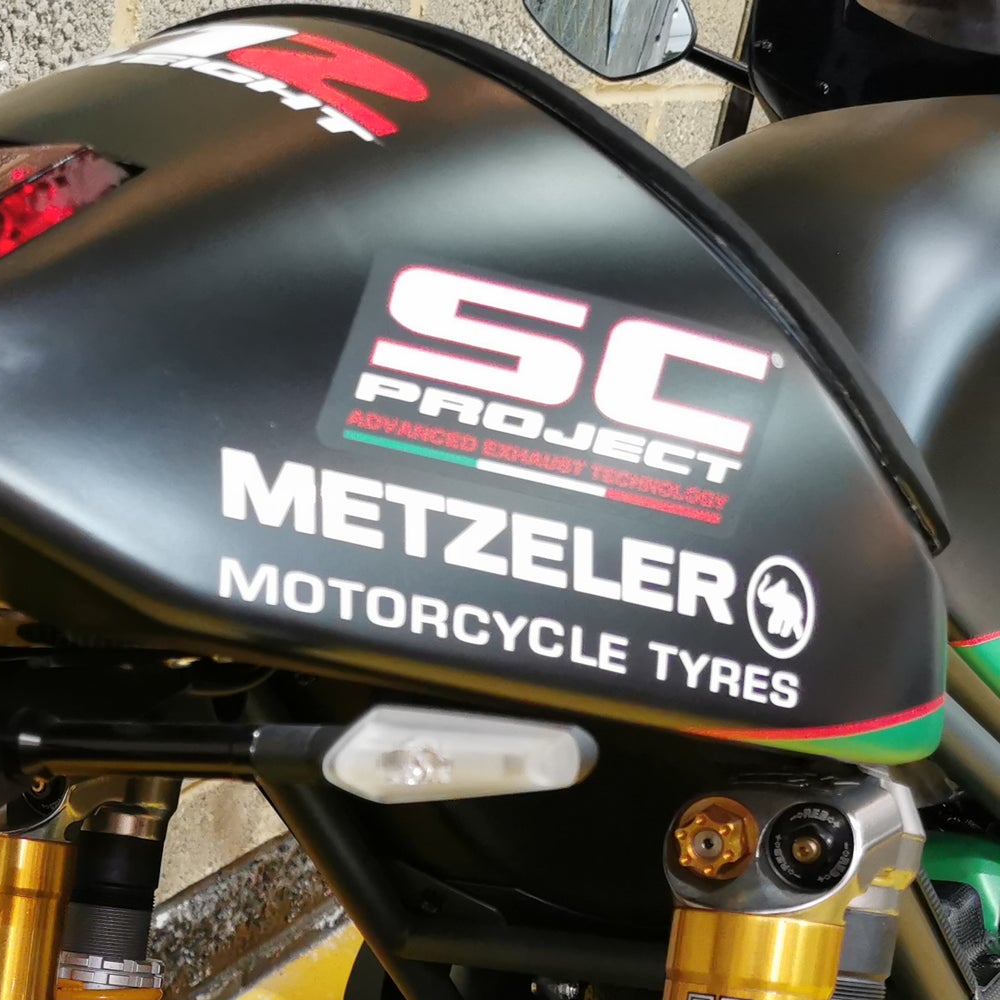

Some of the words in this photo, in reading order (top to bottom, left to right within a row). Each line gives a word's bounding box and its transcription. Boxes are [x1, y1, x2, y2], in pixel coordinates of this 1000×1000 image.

[354, 371, 743, 484] PROJECT
[369, 263, 770, 454] SC
[220, 446, 736, 625] METZELER
[347, 408, 479, 453] ADVANCED
[482, 438, 585, 476] EXHAUST
[590, 463, 729, 511] TECHNOLOGY
[218, 556, 629, 674] MOTORCYCLE
[649, 641, 800, 709] TYRES
